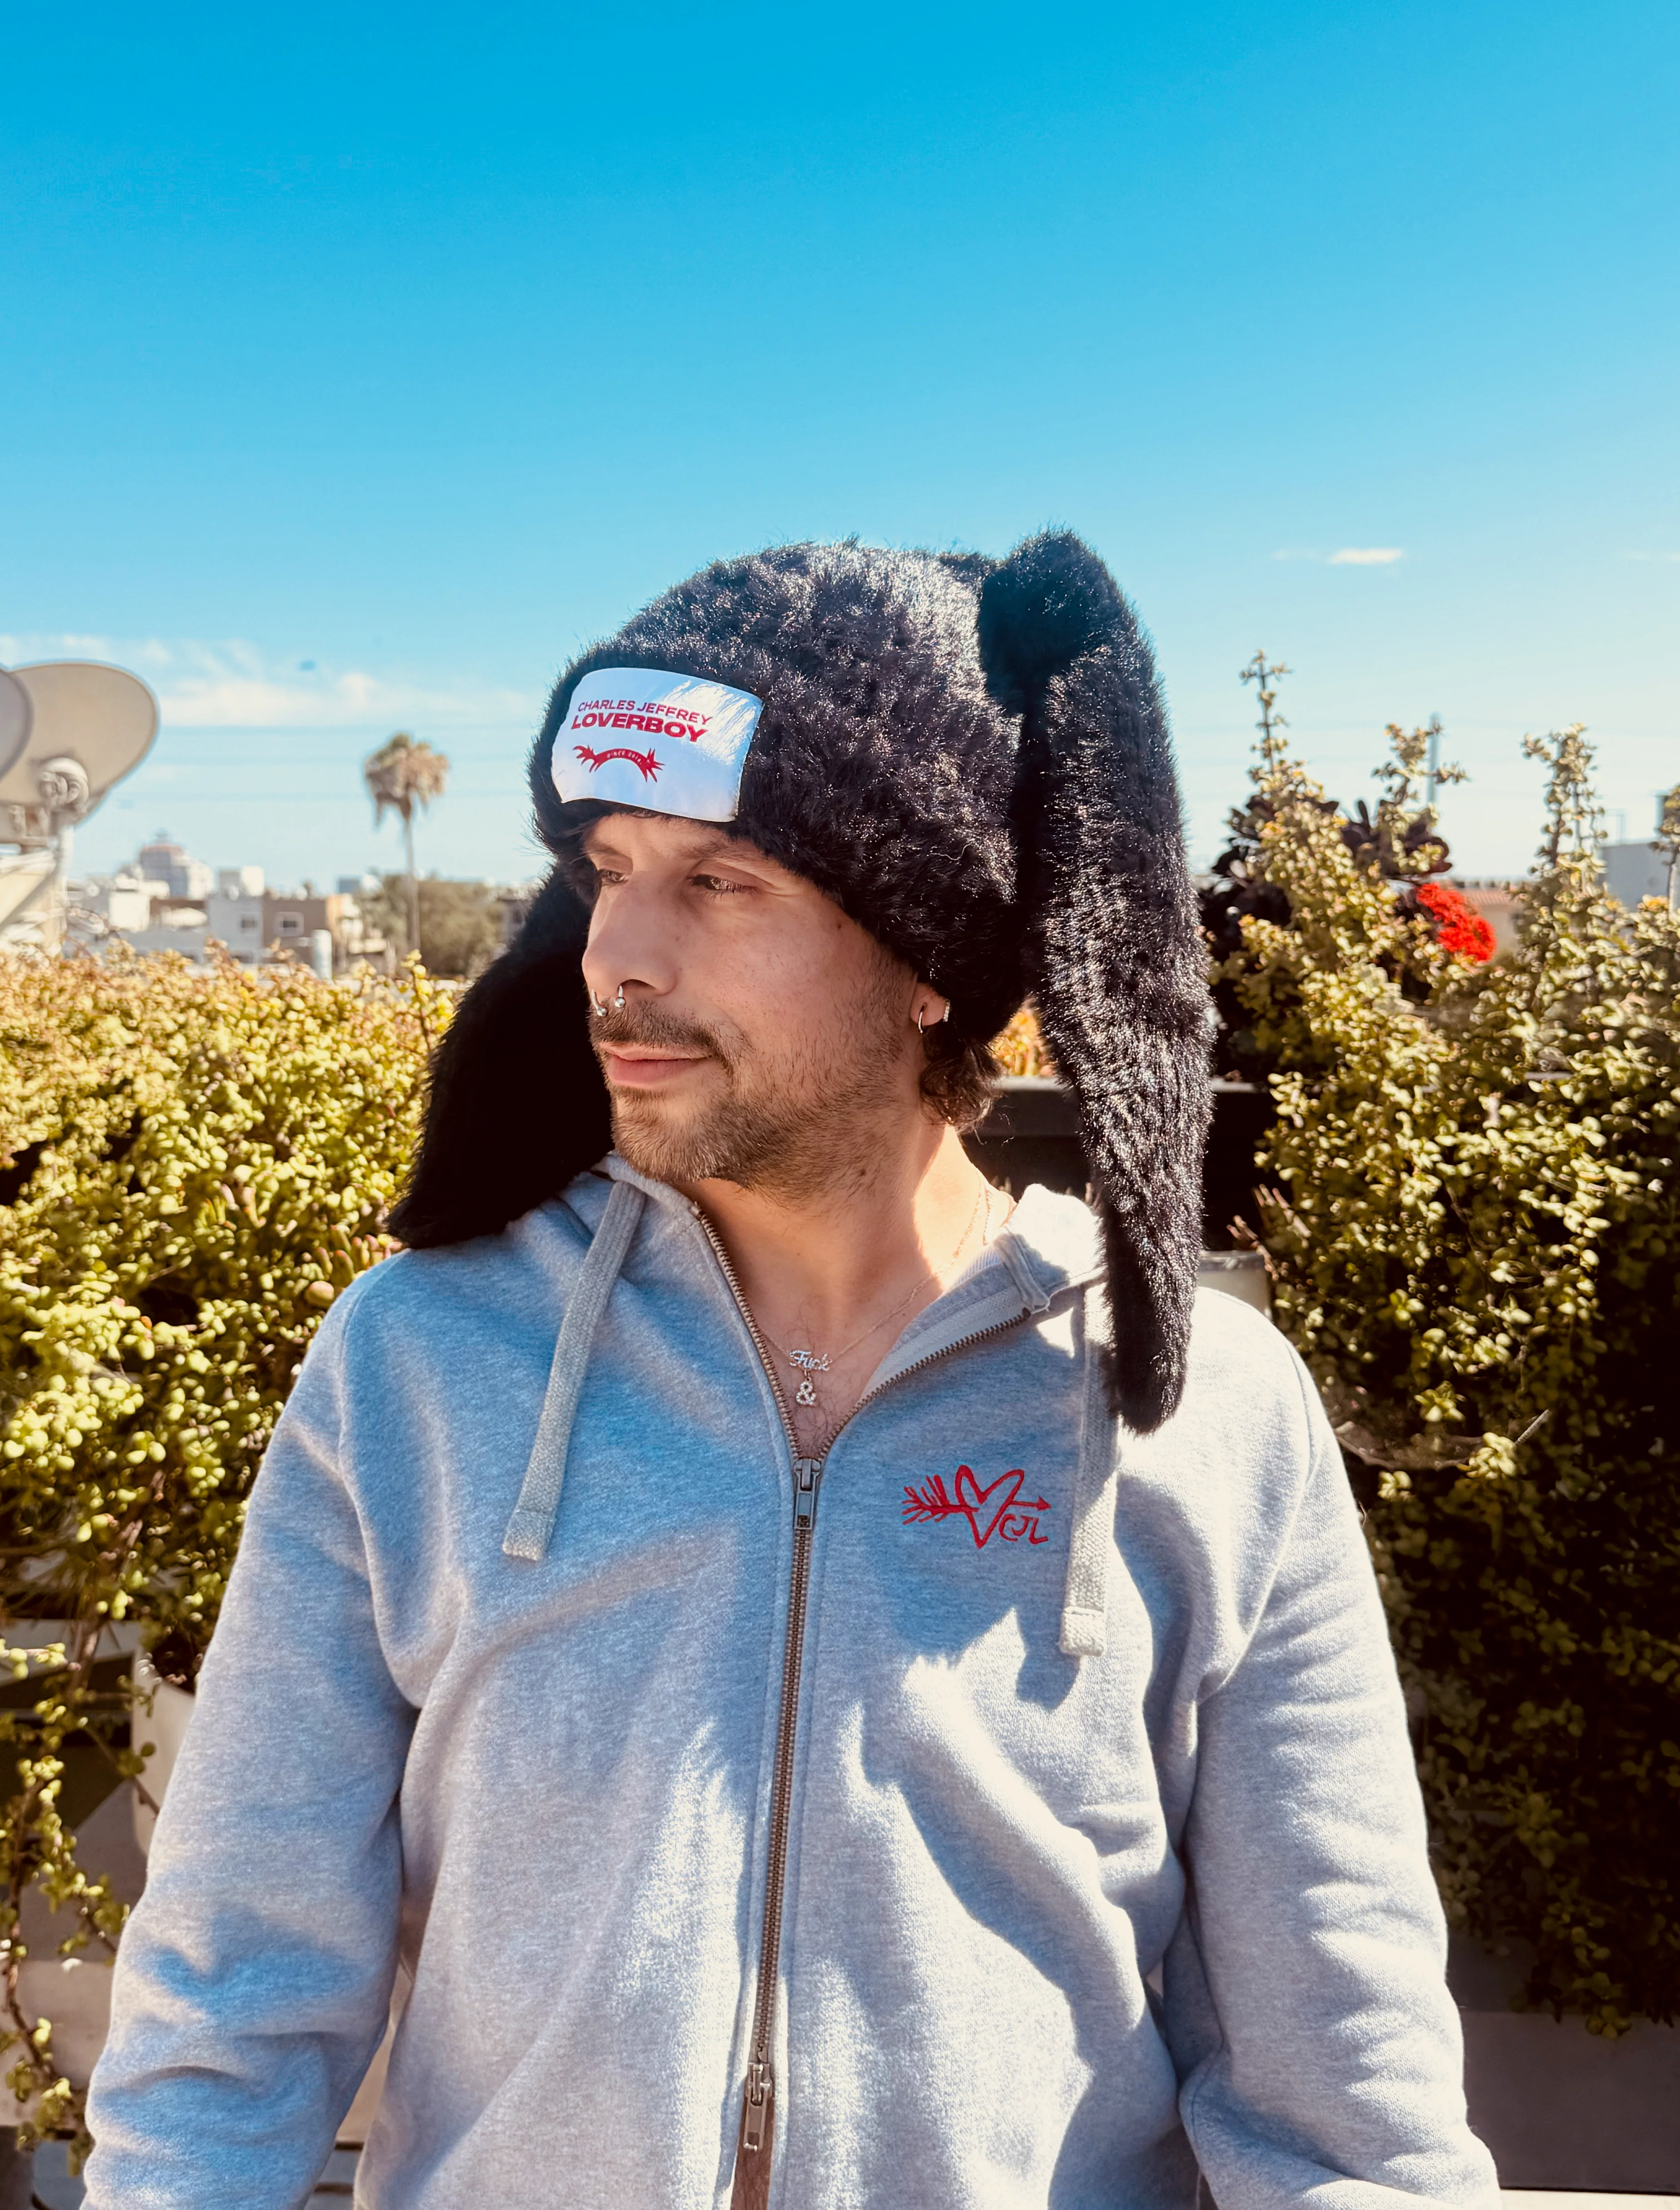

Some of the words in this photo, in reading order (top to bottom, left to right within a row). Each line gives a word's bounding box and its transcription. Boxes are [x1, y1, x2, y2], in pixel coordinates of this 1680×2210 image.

[578, 700, 635, 712] CHARLES
[637, 702, 713, 725] JEFFREY
[571, 713, 708, 742] LOVERBOY
